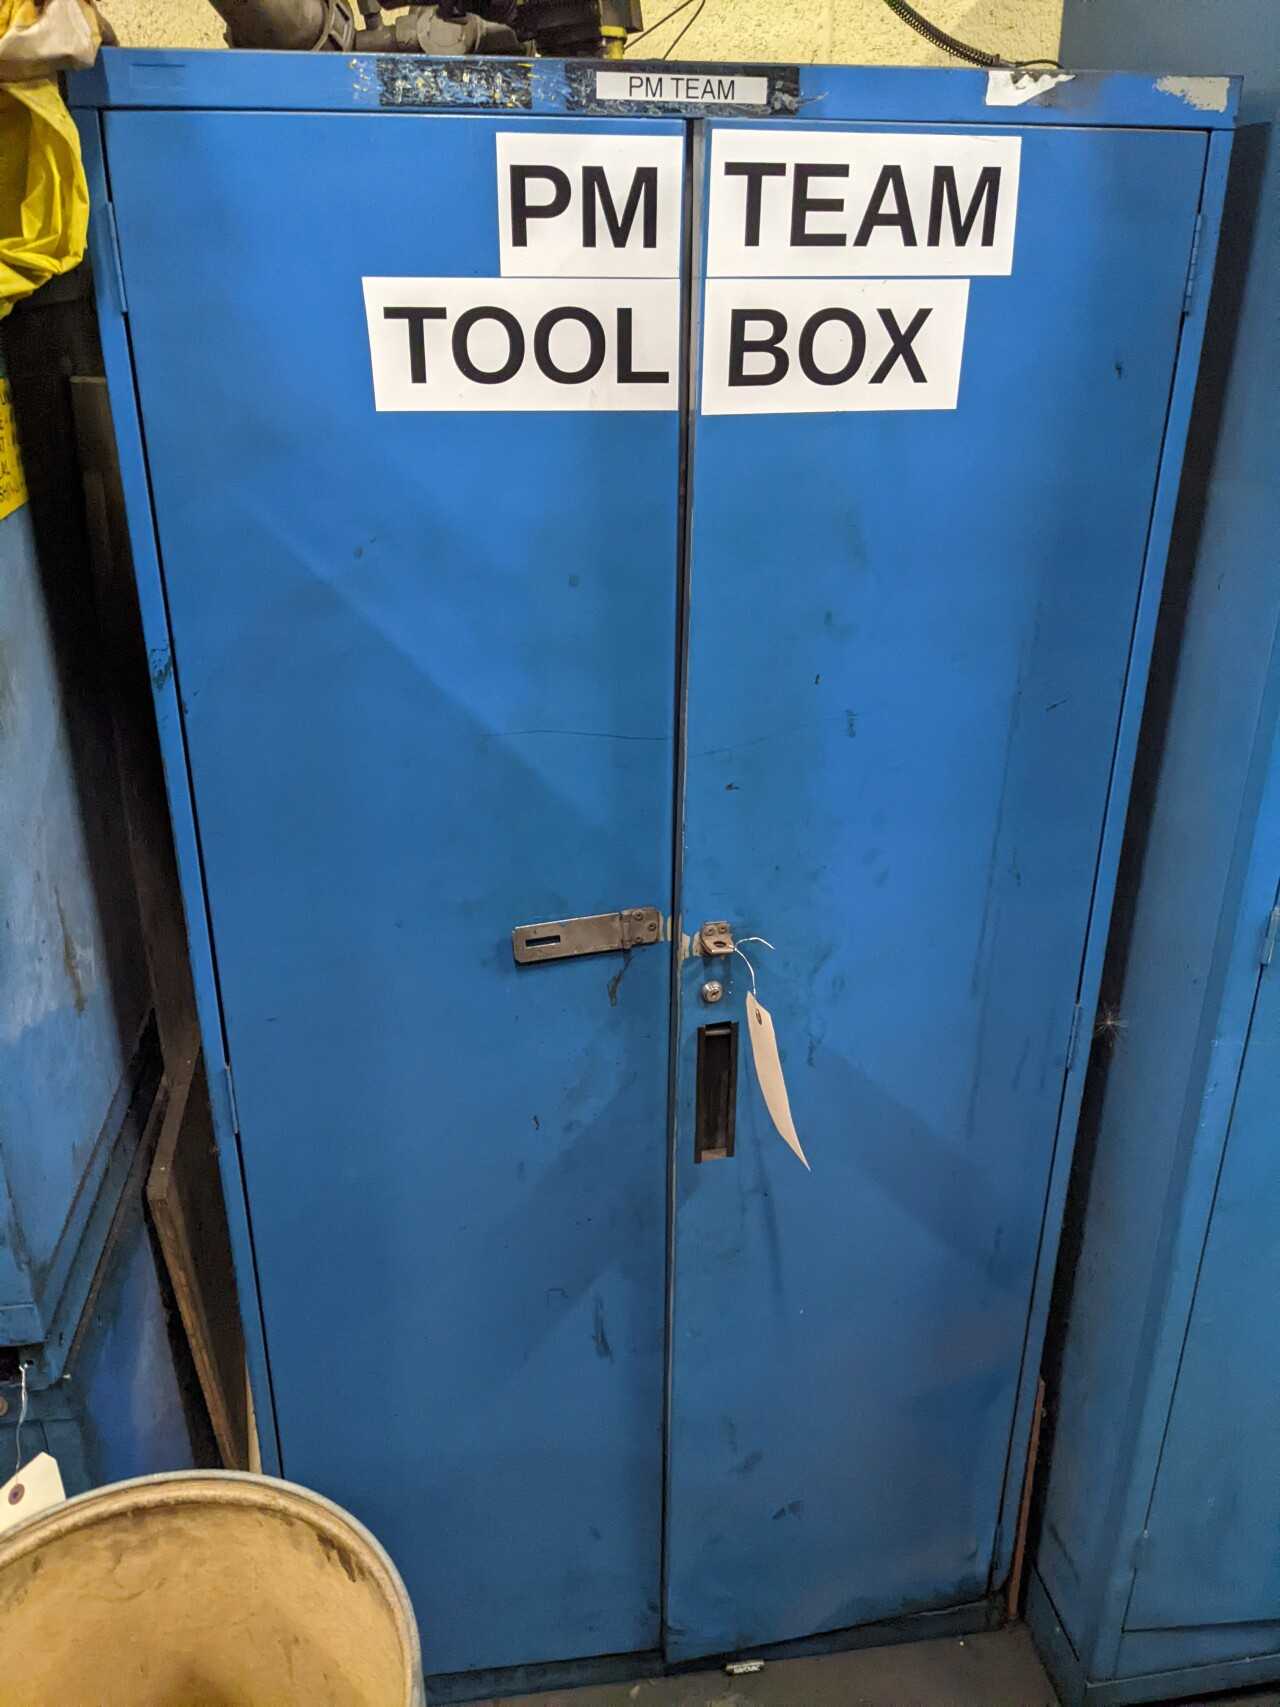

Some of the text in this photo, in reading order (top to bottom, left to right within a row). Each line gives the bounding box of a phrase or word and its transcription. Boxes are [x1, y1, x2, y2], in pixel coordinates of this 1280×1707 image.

[629, 76, 735, 101] PM TEAM
[510, 162, 1002, 249] PM TEAM
[383, 306, 933, 387] TOOL BOX
